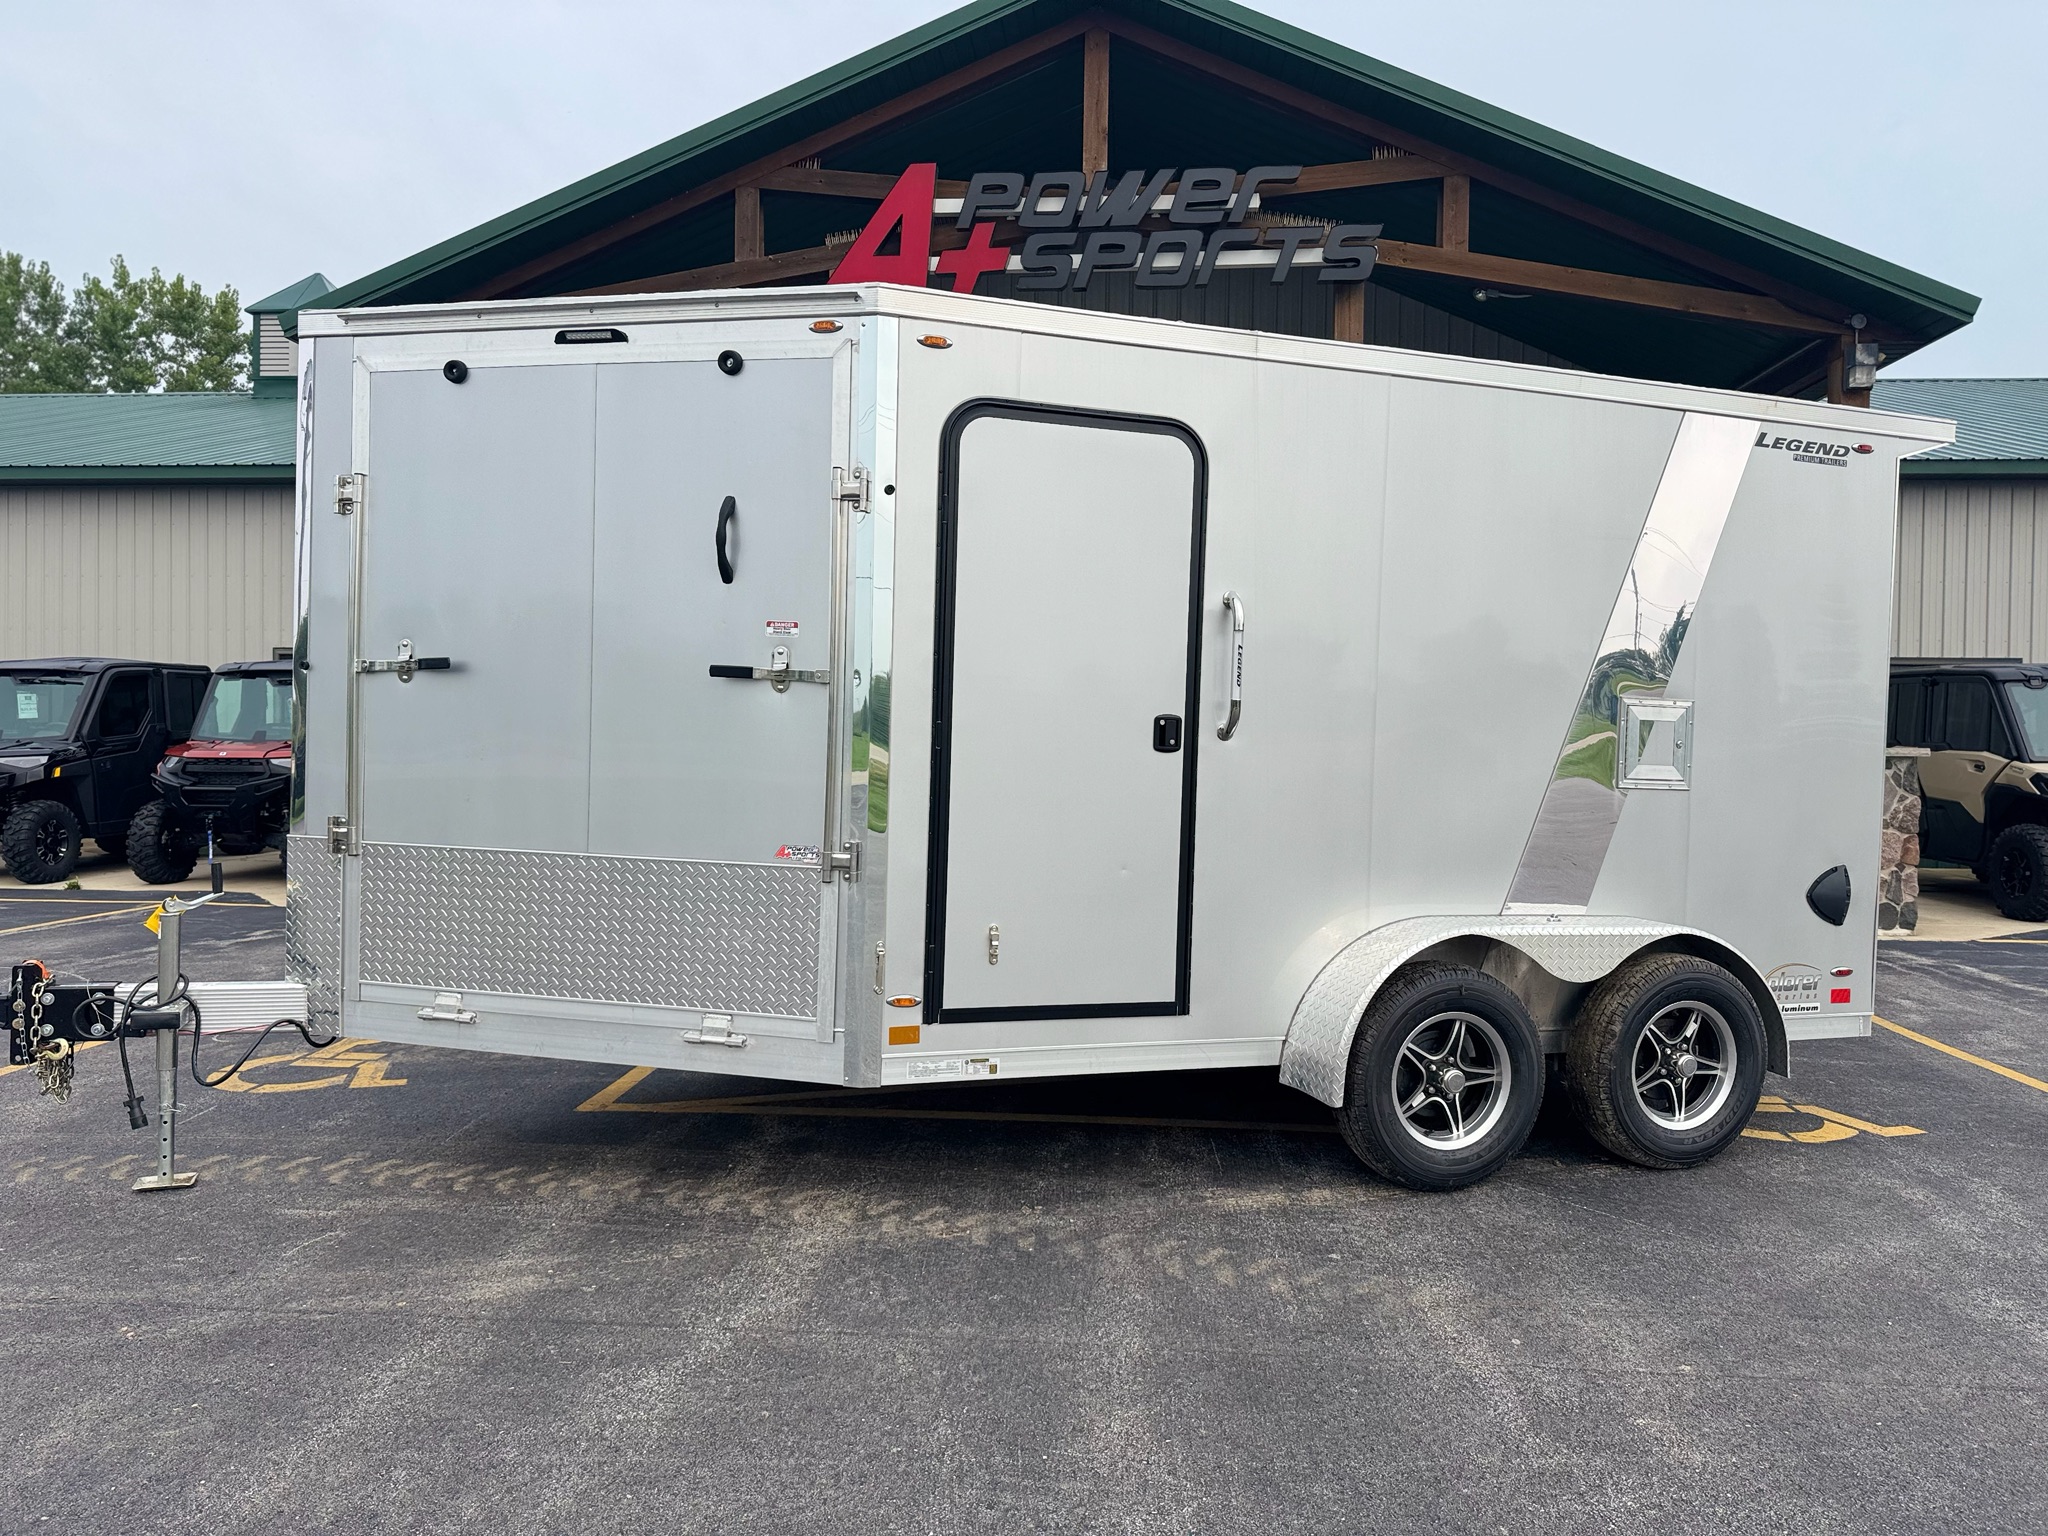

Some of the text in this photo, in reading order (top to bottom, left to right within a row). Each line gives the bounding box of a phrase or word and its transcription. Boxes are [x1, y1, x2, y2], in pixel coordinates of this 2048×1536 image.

[1754, 432, 1850, 457] LEGEND
[1793, 454, 1848, 467] PREMIUM TRAILERS
[1776, 993, 1818, 1001] Series
[1781, 1005, 1819, 1013] luminum
